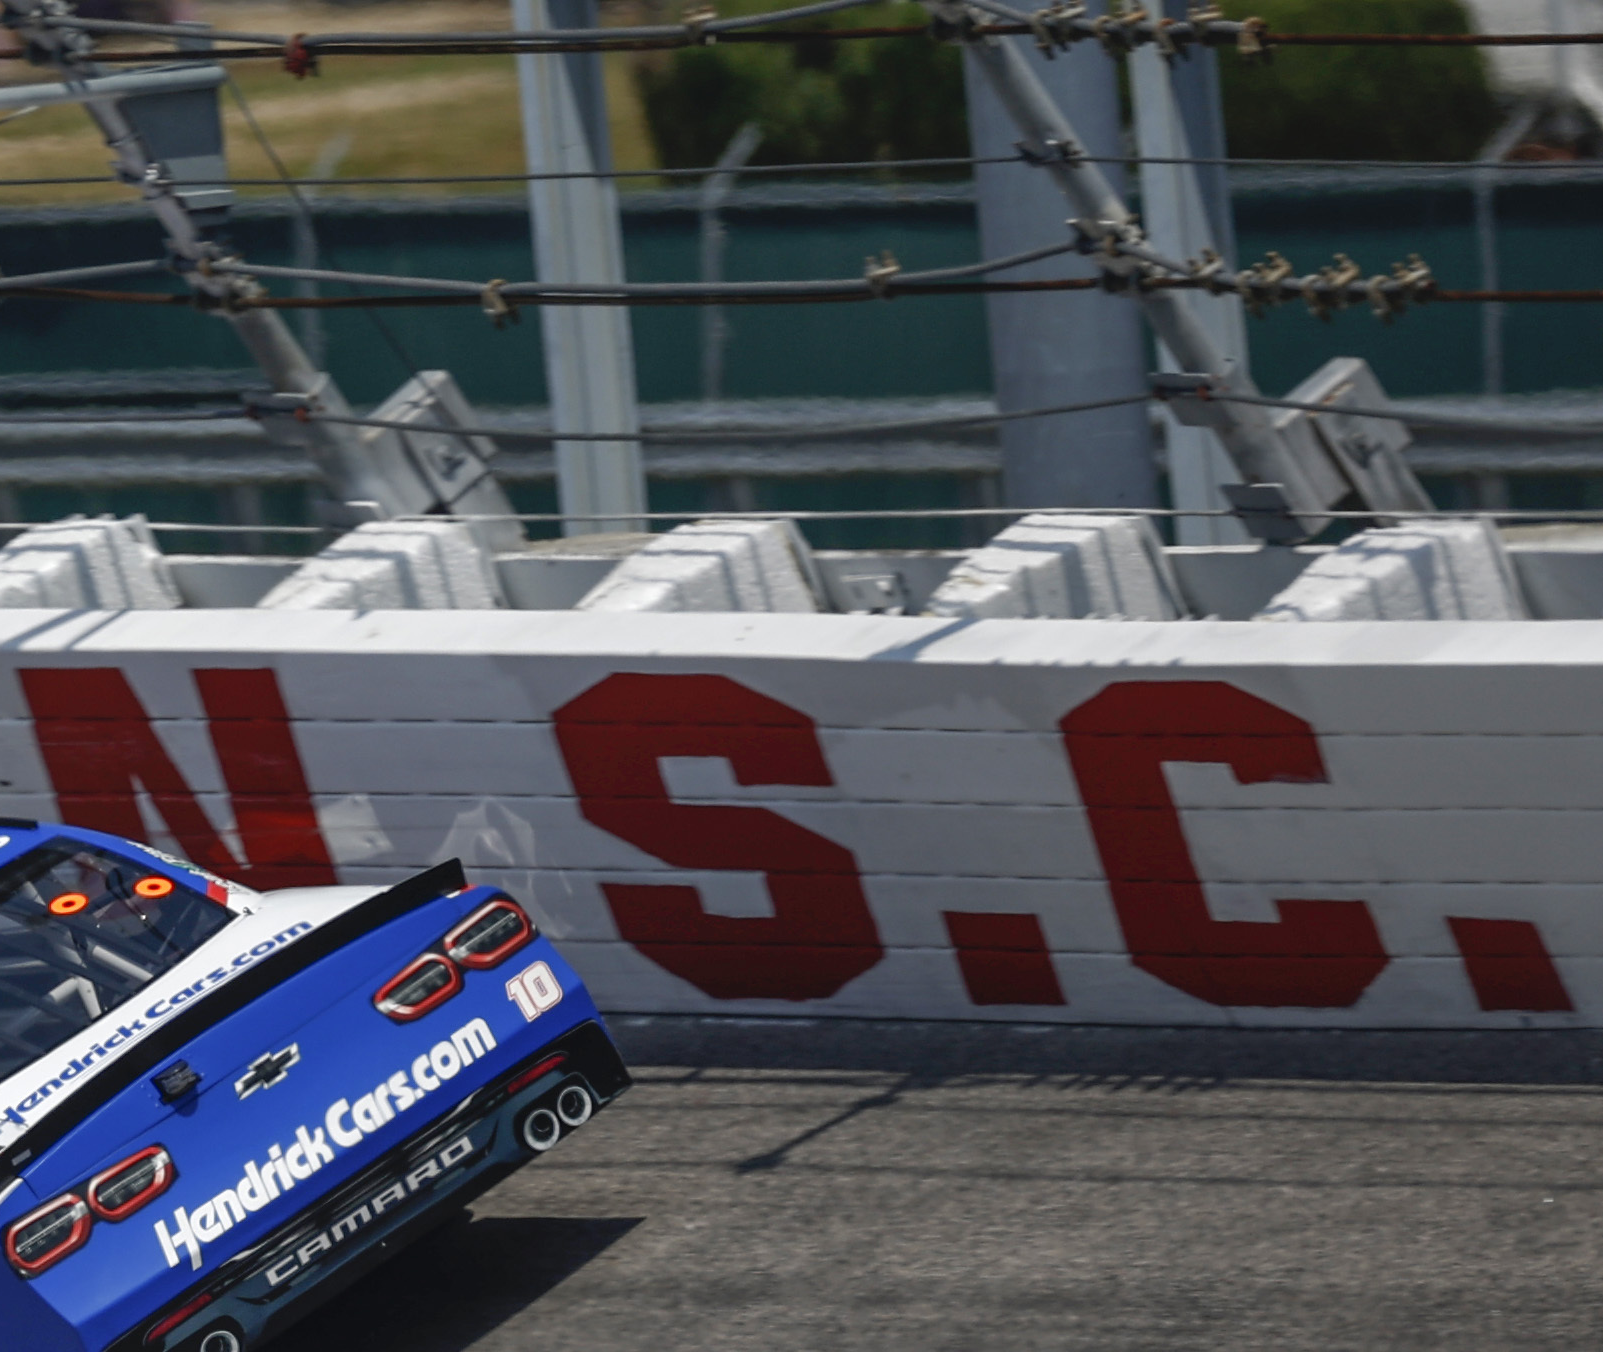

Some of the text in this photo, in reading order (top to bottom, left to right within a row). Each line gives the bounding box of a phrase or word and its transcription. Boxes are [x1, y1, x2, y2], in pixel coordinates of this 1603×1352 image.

[551, 672, 1576, 1013] S.C.
[505, 961, 563, 1023] 10
[265, 1136, 475, 1286] CAMARO
